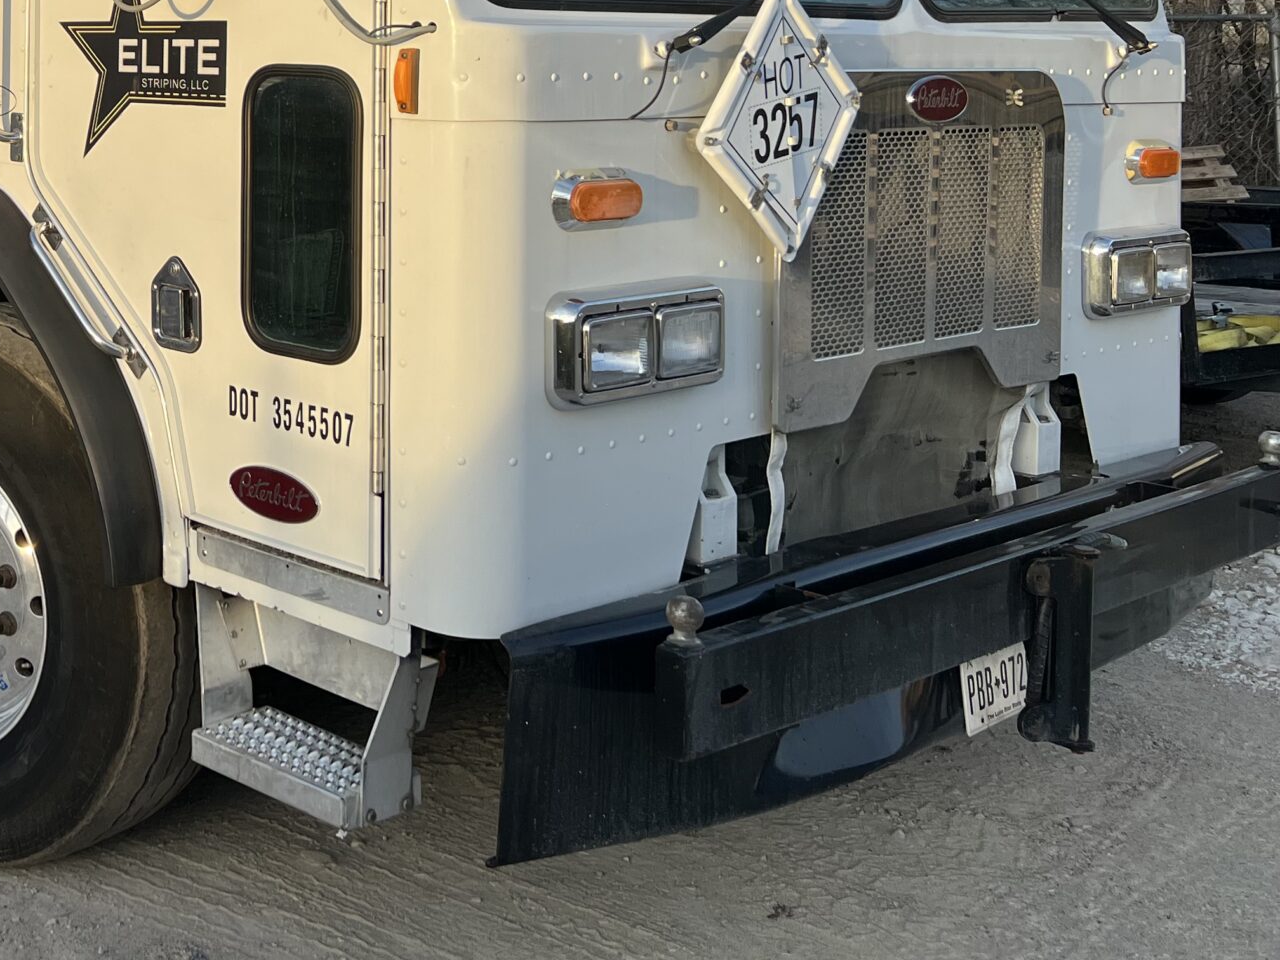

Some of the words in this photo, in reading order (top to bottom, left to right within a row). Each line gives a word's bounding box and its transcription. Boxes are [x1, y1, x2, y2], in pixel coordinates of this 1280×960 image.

[118, 38, 220, 76] ELITE
[763, 53, 806, 99] HOT
[190, 79, 209, 91] LLC
[917, 85, 963, 110] Peterbilt
[752, 92, 819, 164] 3257
[228, 385, 259, 422] DOT
[272, 396, 354, 447] 3545507
[238, 471, 309, 513] Peterbilt
